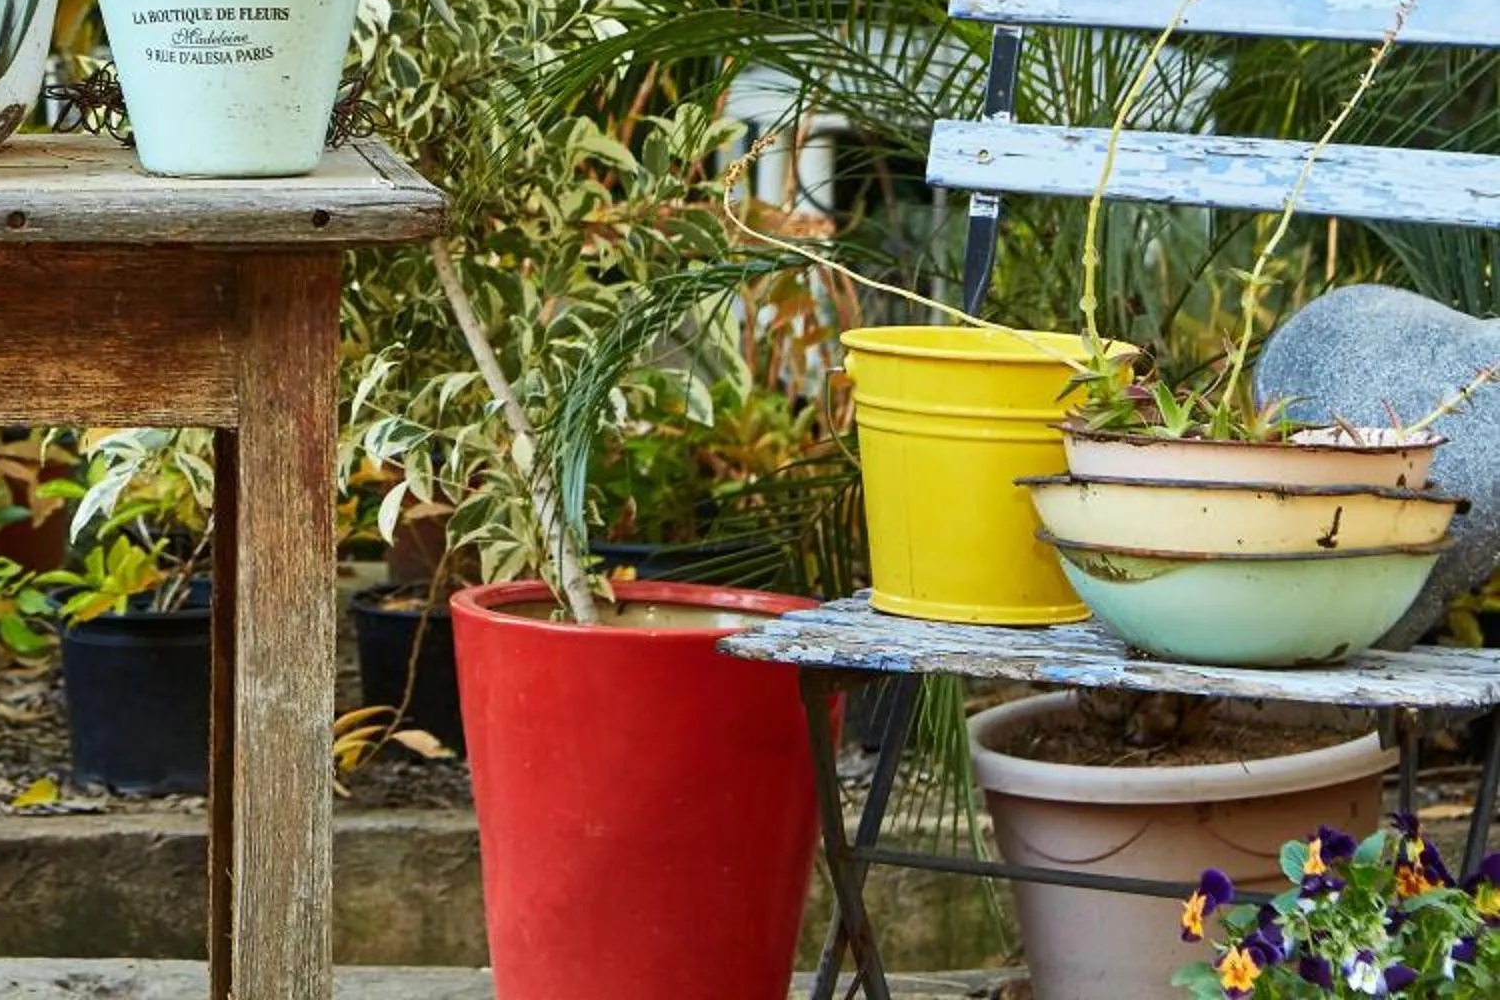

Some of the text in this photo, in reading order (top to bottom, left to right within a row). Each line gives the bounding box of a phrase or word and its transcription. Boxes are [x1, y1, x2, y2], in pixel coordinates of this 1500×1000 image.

[149, 8, 213, 25] BOUTIQUE
[217, 7, 235, 21] DE
[239, 7, 290, 21] FLEURS
[171, 27, 252, 47] Madeleine
[145, 46, 274, 65] 9 RUE D'ALESIA PARIS
